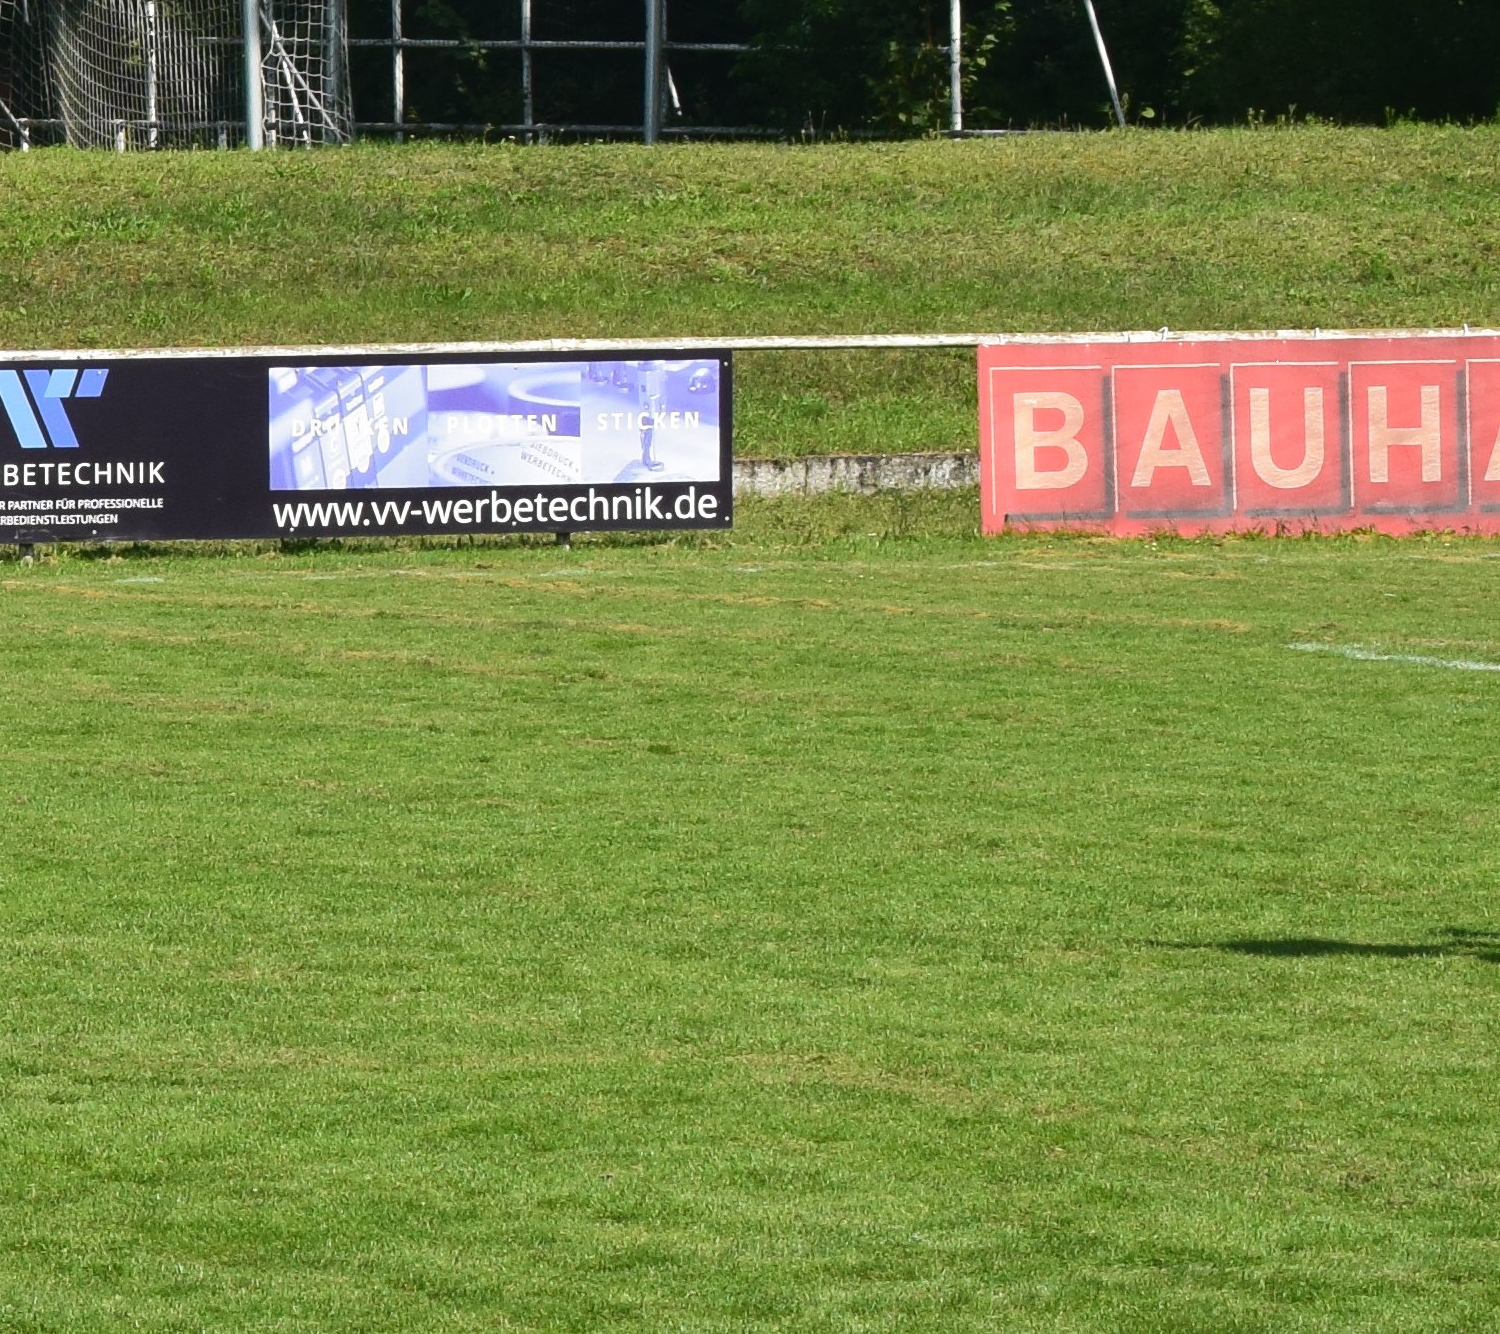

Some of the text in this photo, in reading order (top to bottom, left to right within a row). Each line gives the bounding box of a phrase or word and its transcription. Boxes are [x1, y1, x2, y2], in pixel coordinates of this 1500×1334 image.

[447, 413, 557, 433] PLOTTEN
[596, 411, 699, 431] STICKEN
[1013, 384, 1500, 490] BAUH
[8, 499, 54, 510] PARTNER
[55, 497, 76, 509] FÜR
[78, 497, 164, 509] PROFESSIONELLE
[273, 486, 718, 527] www.vv-werbetechnik.de
